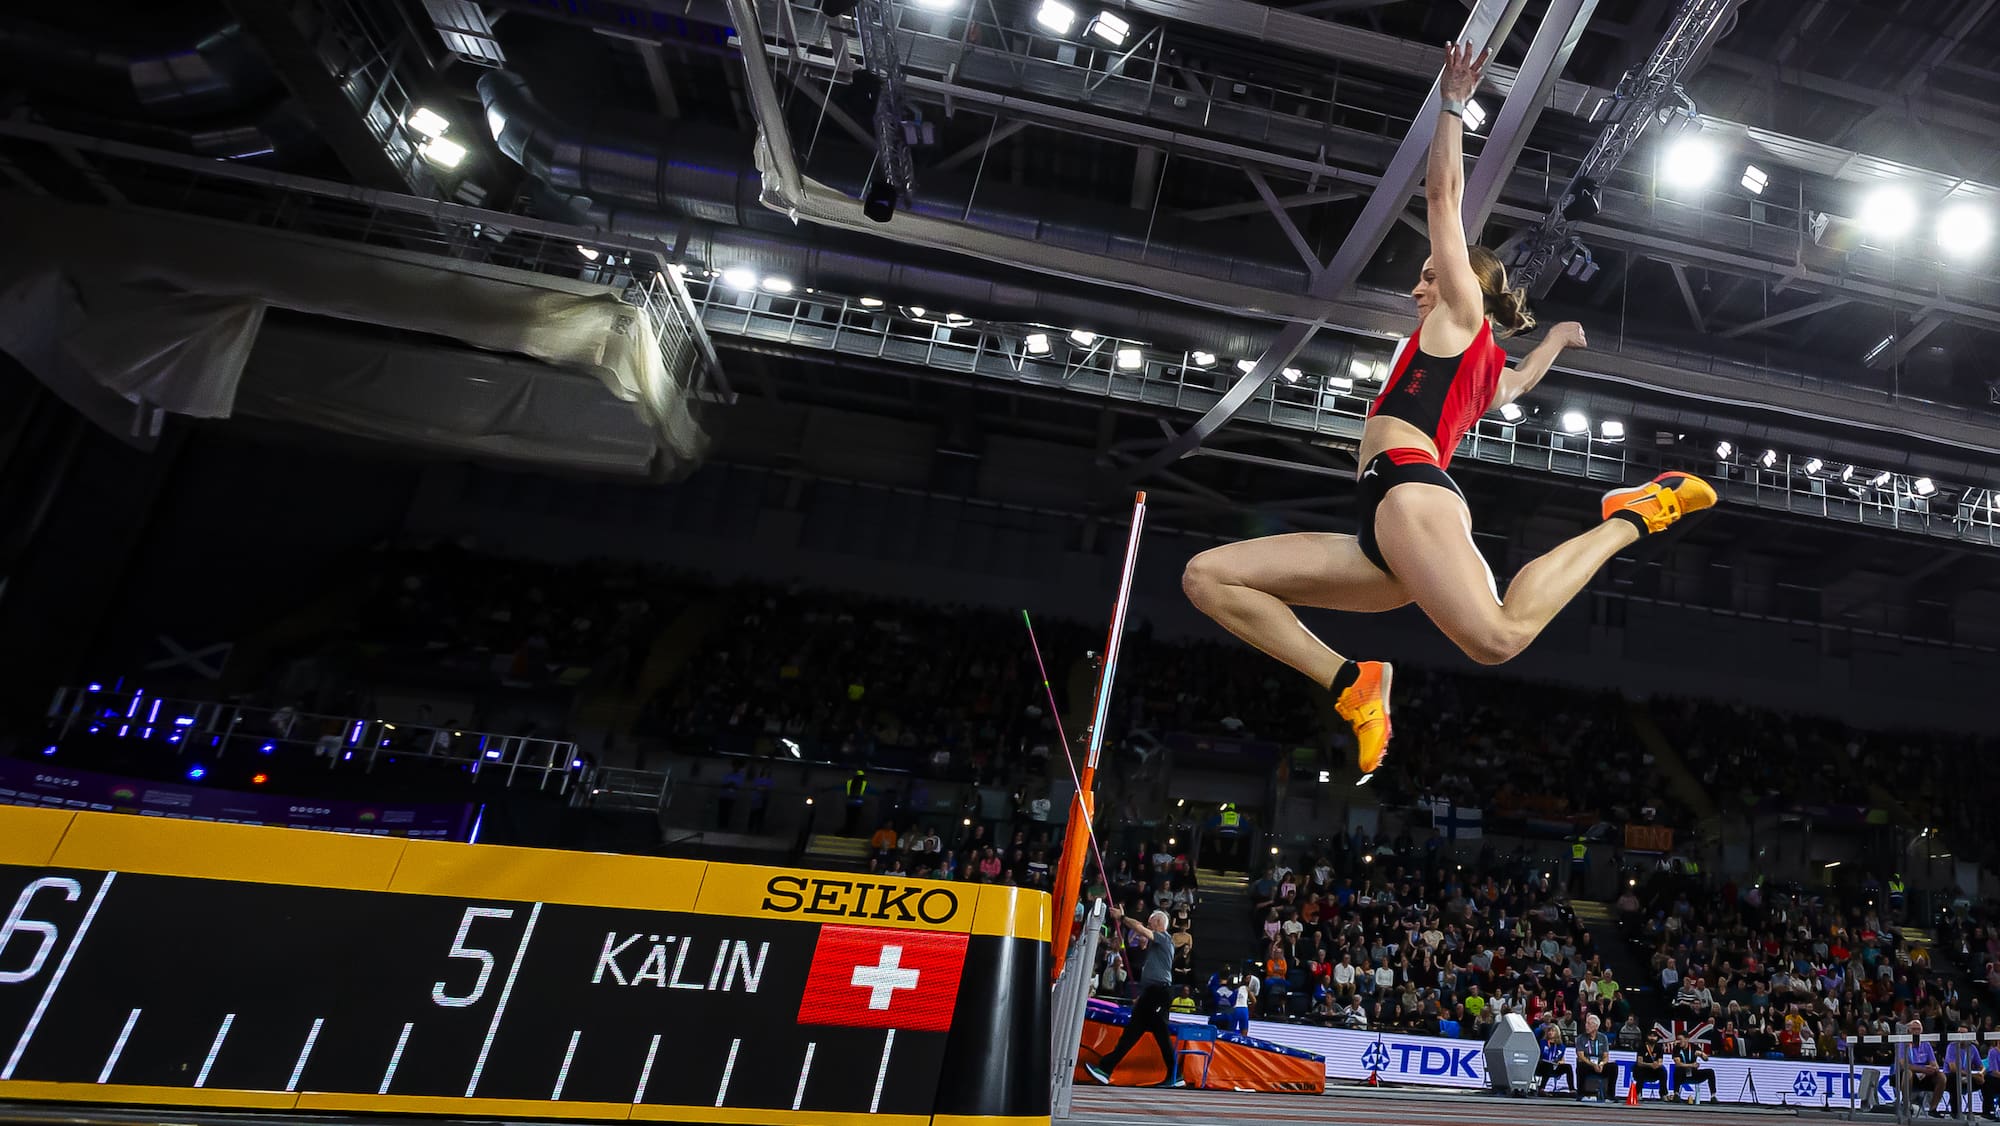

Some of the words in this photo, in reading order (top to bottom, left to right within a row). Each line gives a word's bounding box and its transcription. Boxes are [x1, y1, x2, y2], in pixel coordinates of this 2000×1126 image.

[0, 877, 82, 983] 6
[761, 875, 958, 925] SEIKO
[432, 907, 514, 1007] 5
[591, 931, 770, 993] KÄLIN
[1391, 1043, 1481, 1079] TDK
